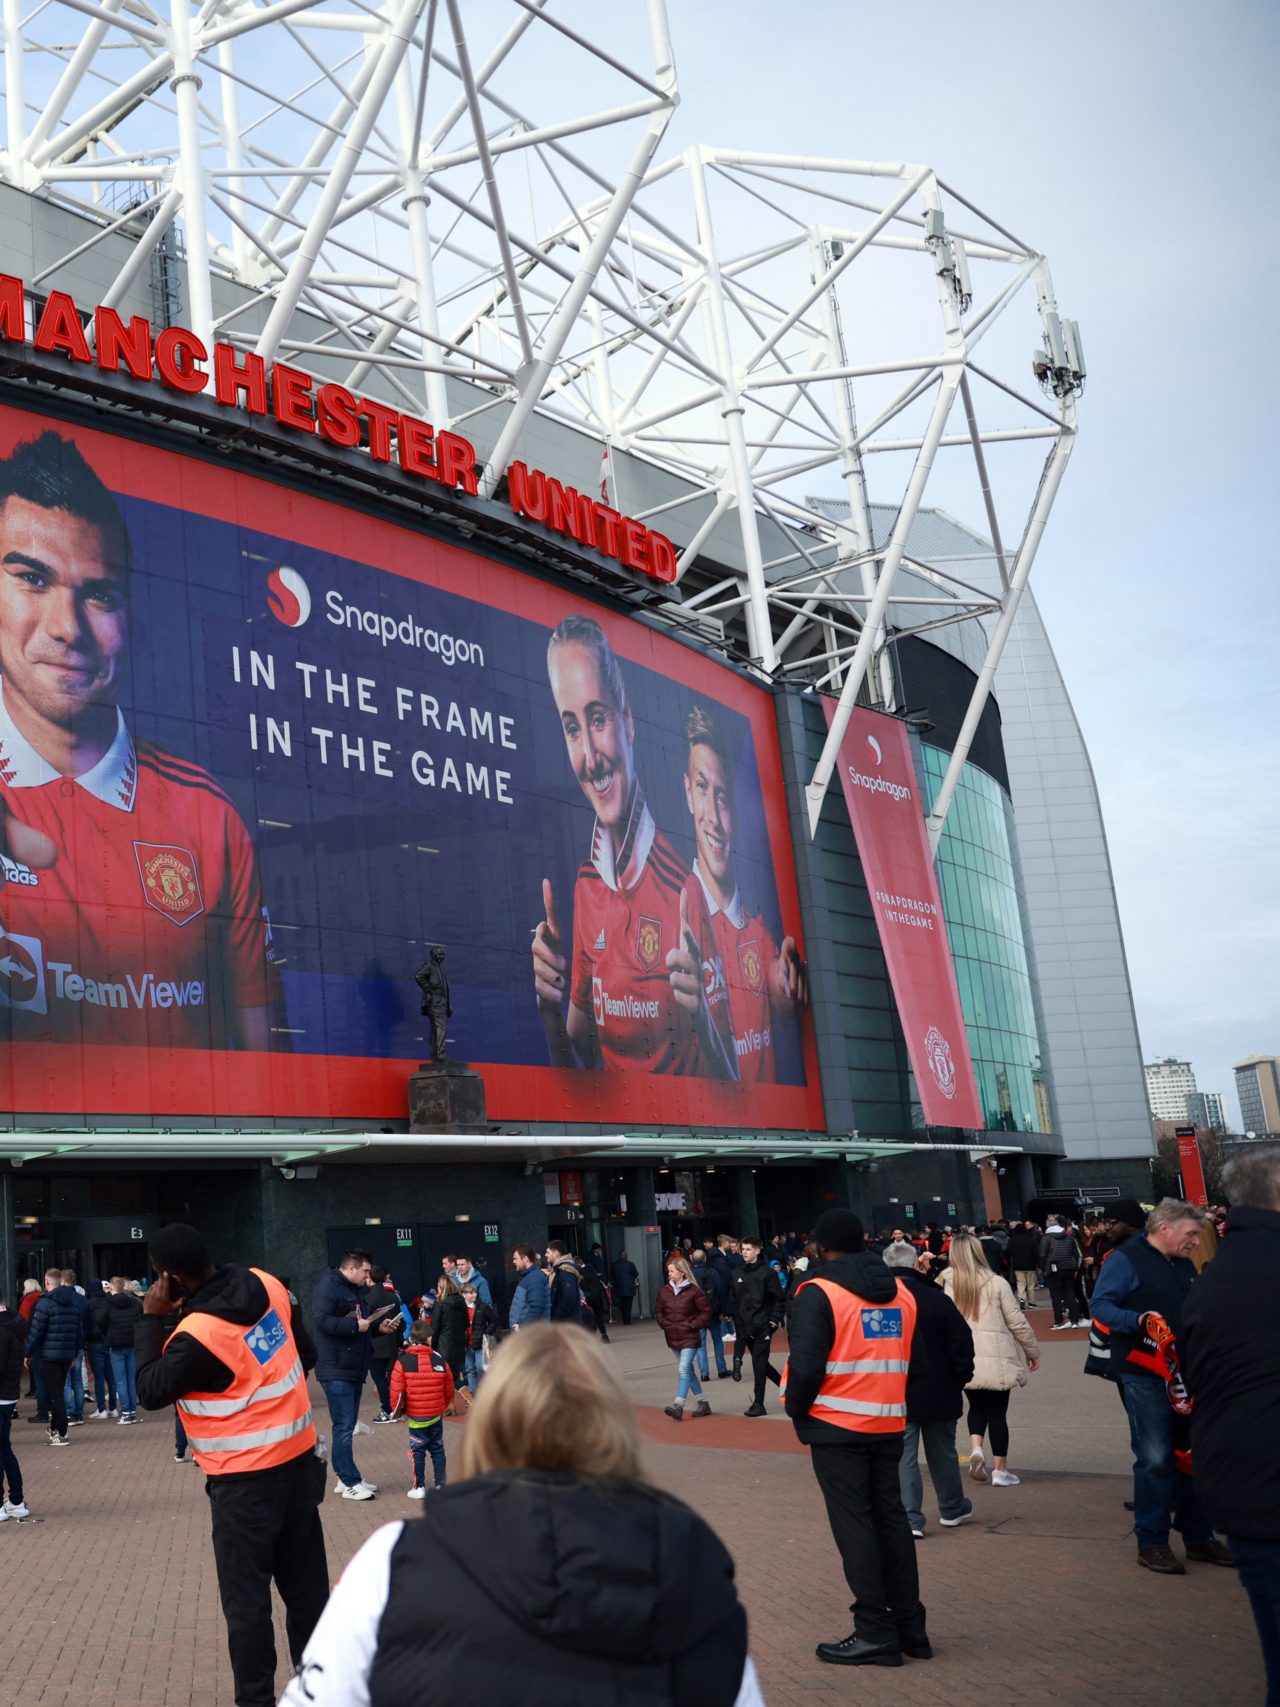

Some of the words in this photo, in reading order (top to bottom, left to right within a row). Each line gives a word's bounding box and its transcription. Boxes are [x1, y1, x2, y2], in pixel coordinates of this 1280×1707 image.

[507, 460, 677, 585] UNITED
[326, 590, 484, 667] Snapdragon
[232, 646, 276, 690] IN
[295, 661, 378, 714] THE
[396, 686, 517, 750] FRAME
[249, 713, 292, 757] IN
[311, 727, 394, 778] THE
[411, 750, 514, 805] GAME
[848, 766, 911, 800] Snapdragon
[602, 992, 659, 1018] TeamViewer
[131, 1227, 143, 1239] E3
[265, 1321, 285, 1345] CSG
